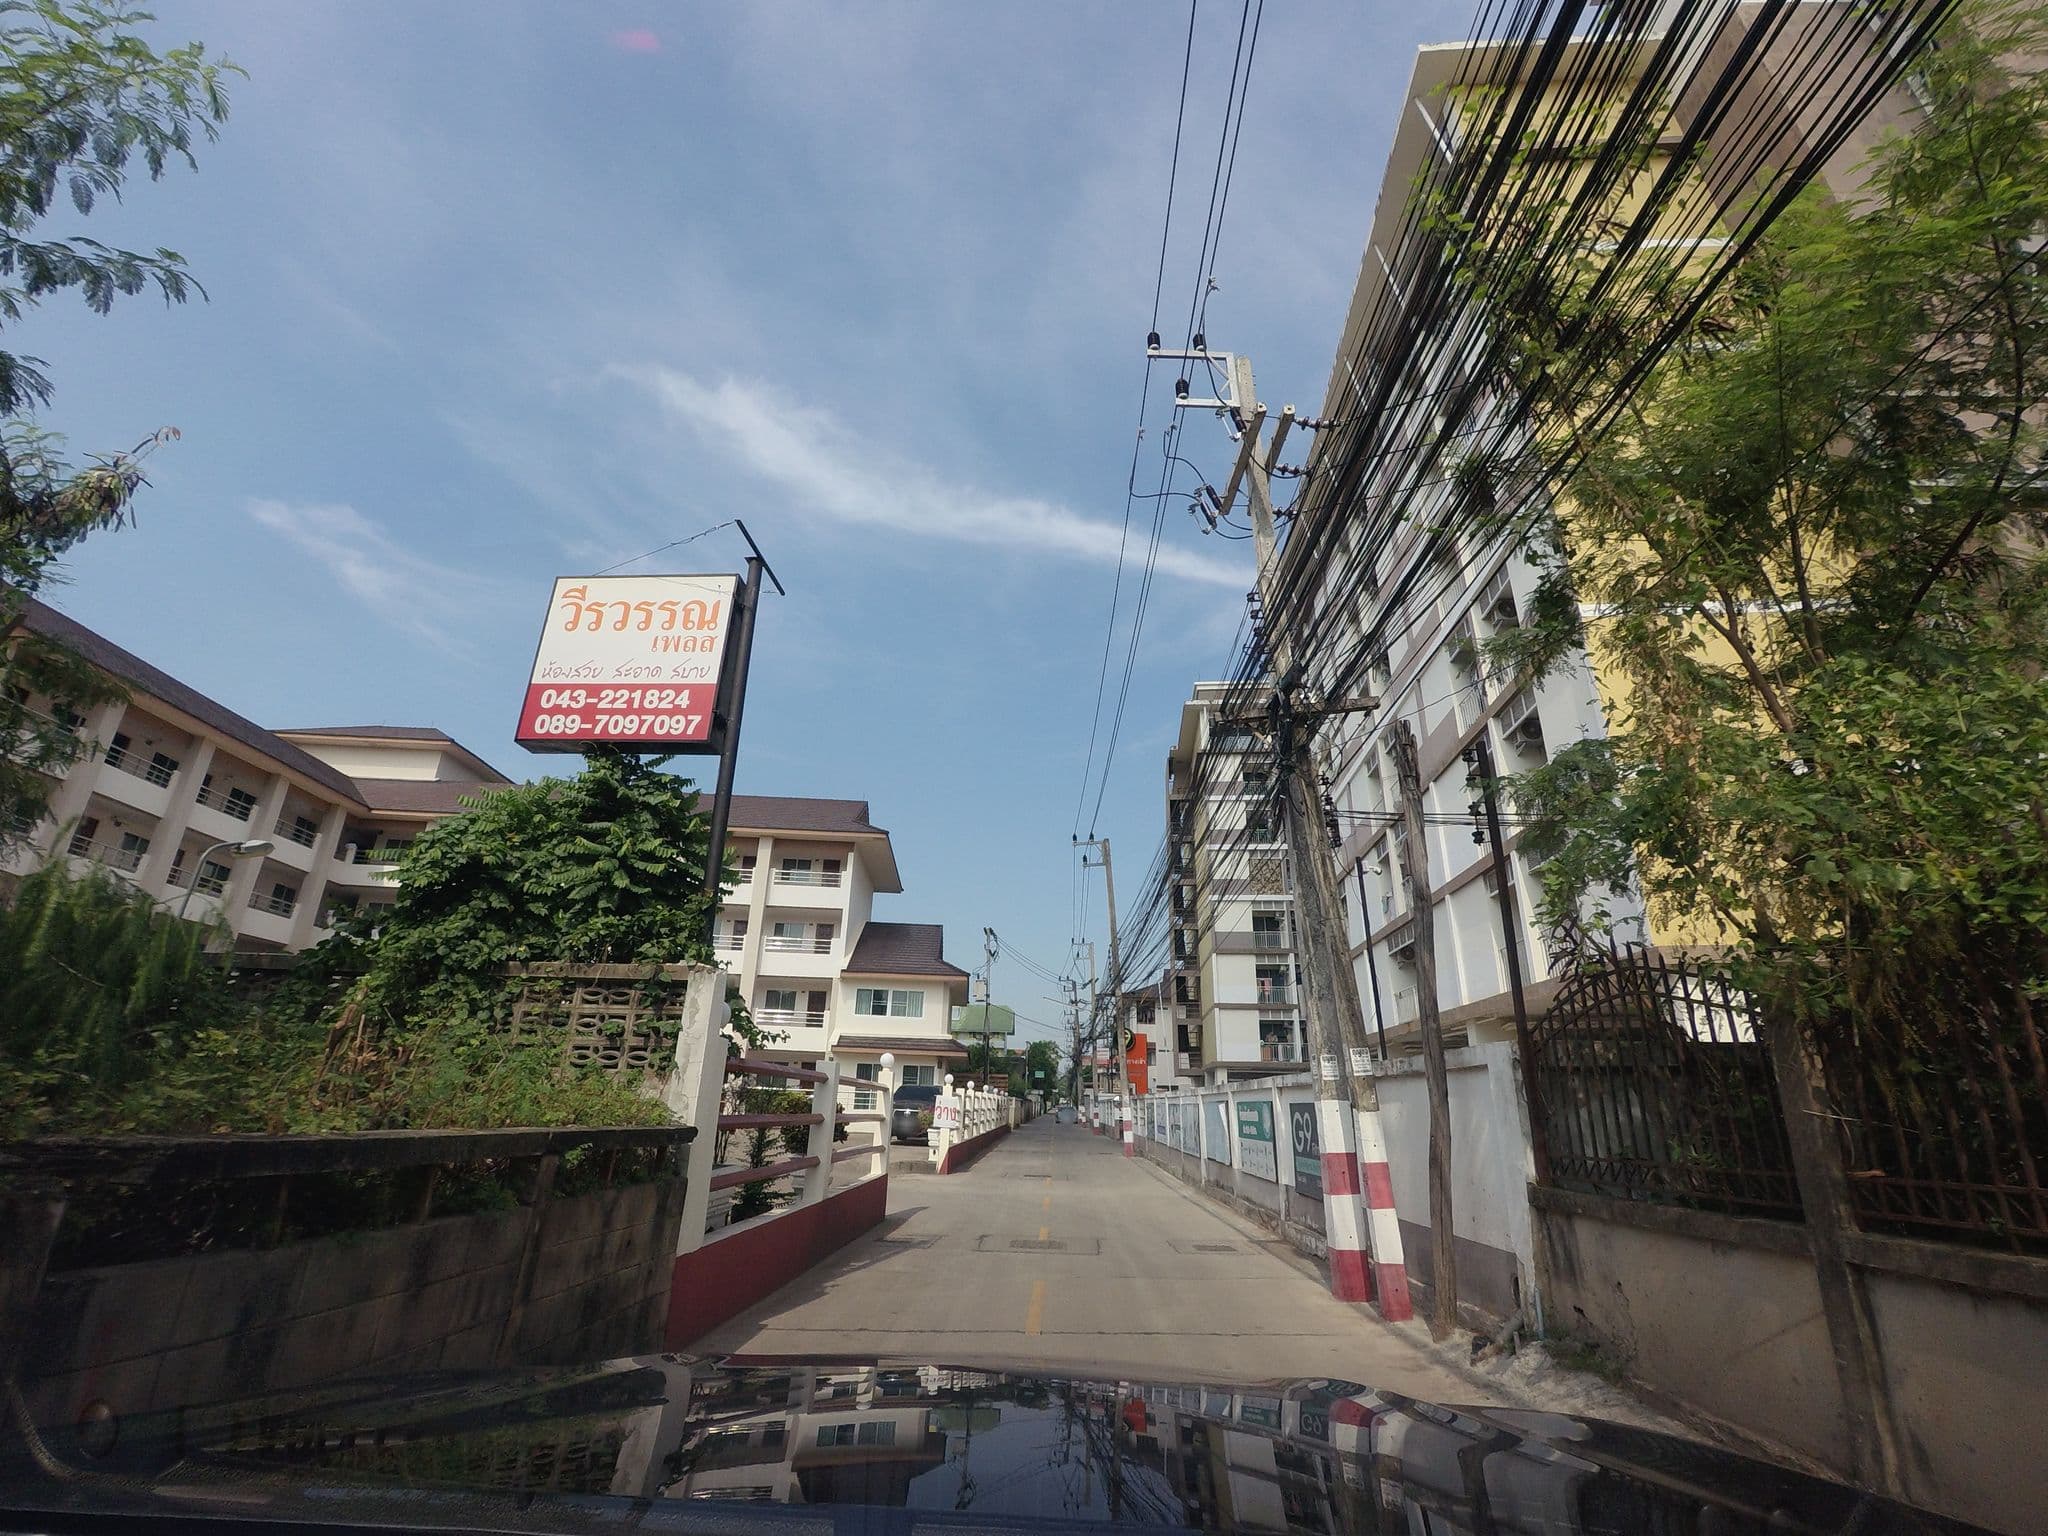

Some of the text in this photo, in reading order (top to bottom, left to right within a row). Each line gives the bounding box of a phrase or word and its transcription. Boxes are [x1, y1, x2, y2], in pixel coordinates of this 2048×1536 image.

[561, 585, 721, 632] วีรวรรณ
[651, 635, 718, 653] เพลส
[541, 658, 711, 679] ห้องสวย สะอาด สบาย
[540, 689, 690, 709] 043-221824
[534, 714, 702, 735] 089-7097097
[1293, 1111, 1312, 1153] G9
